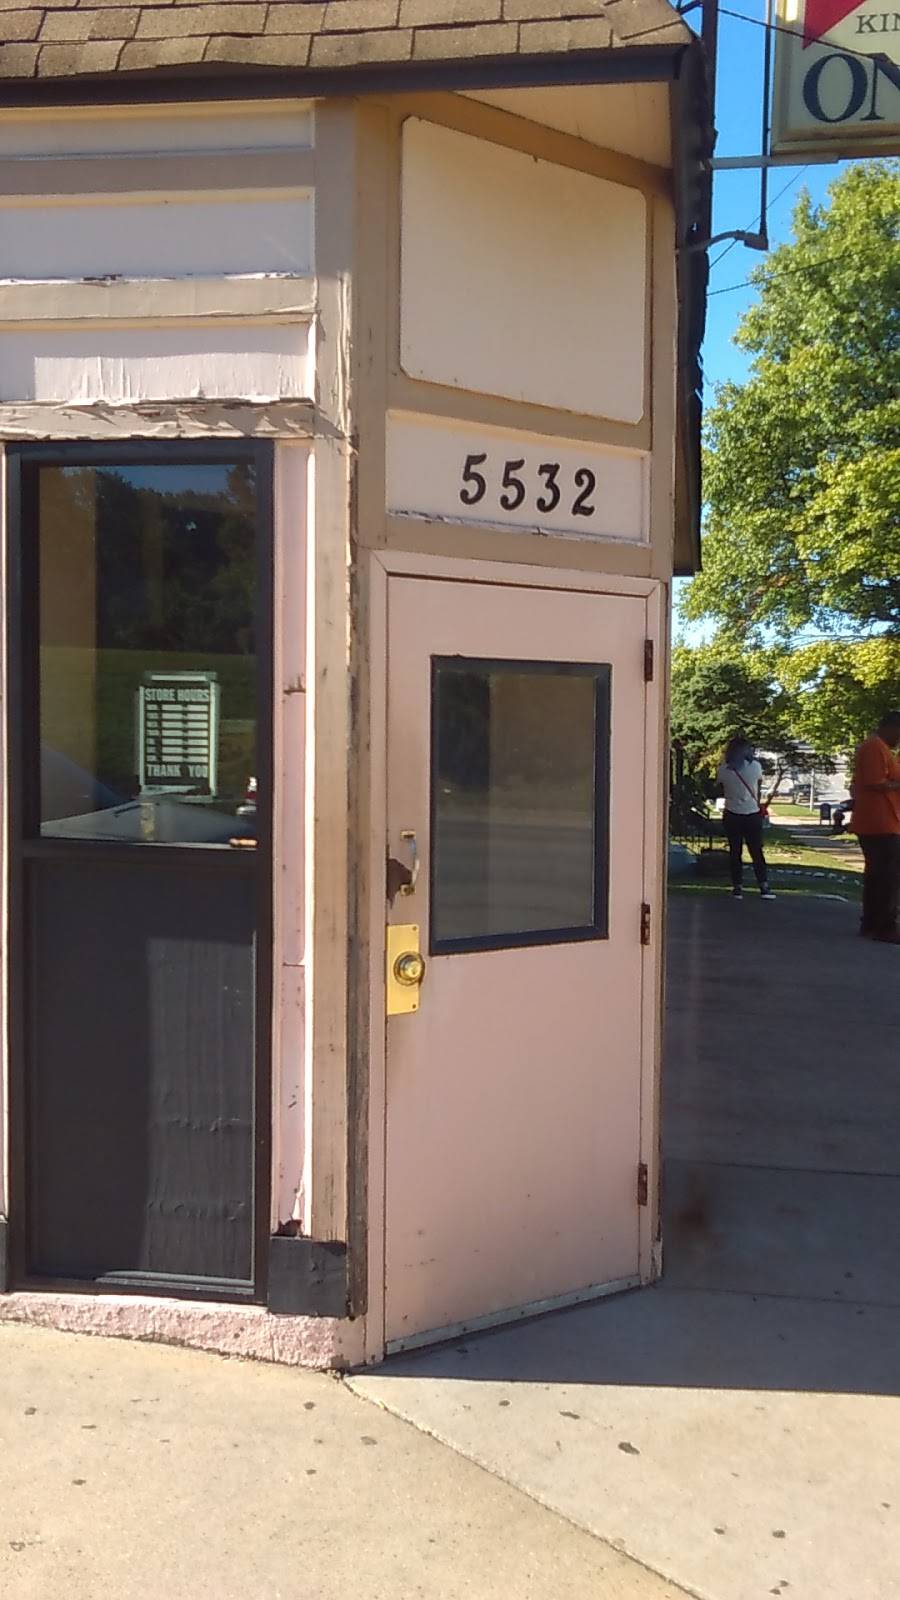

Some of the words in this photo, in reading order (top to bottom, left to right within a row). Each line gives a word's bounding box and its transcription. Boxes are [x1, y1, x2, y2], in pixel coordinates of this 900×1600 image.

[460, 453, 596, 516] 5532
[144, 688, 176, 701] STORE
[177, 689, 209, 702] HOURS
[146, 764, 181, 777] THANK
[187, 765, 208, 778] YOU
